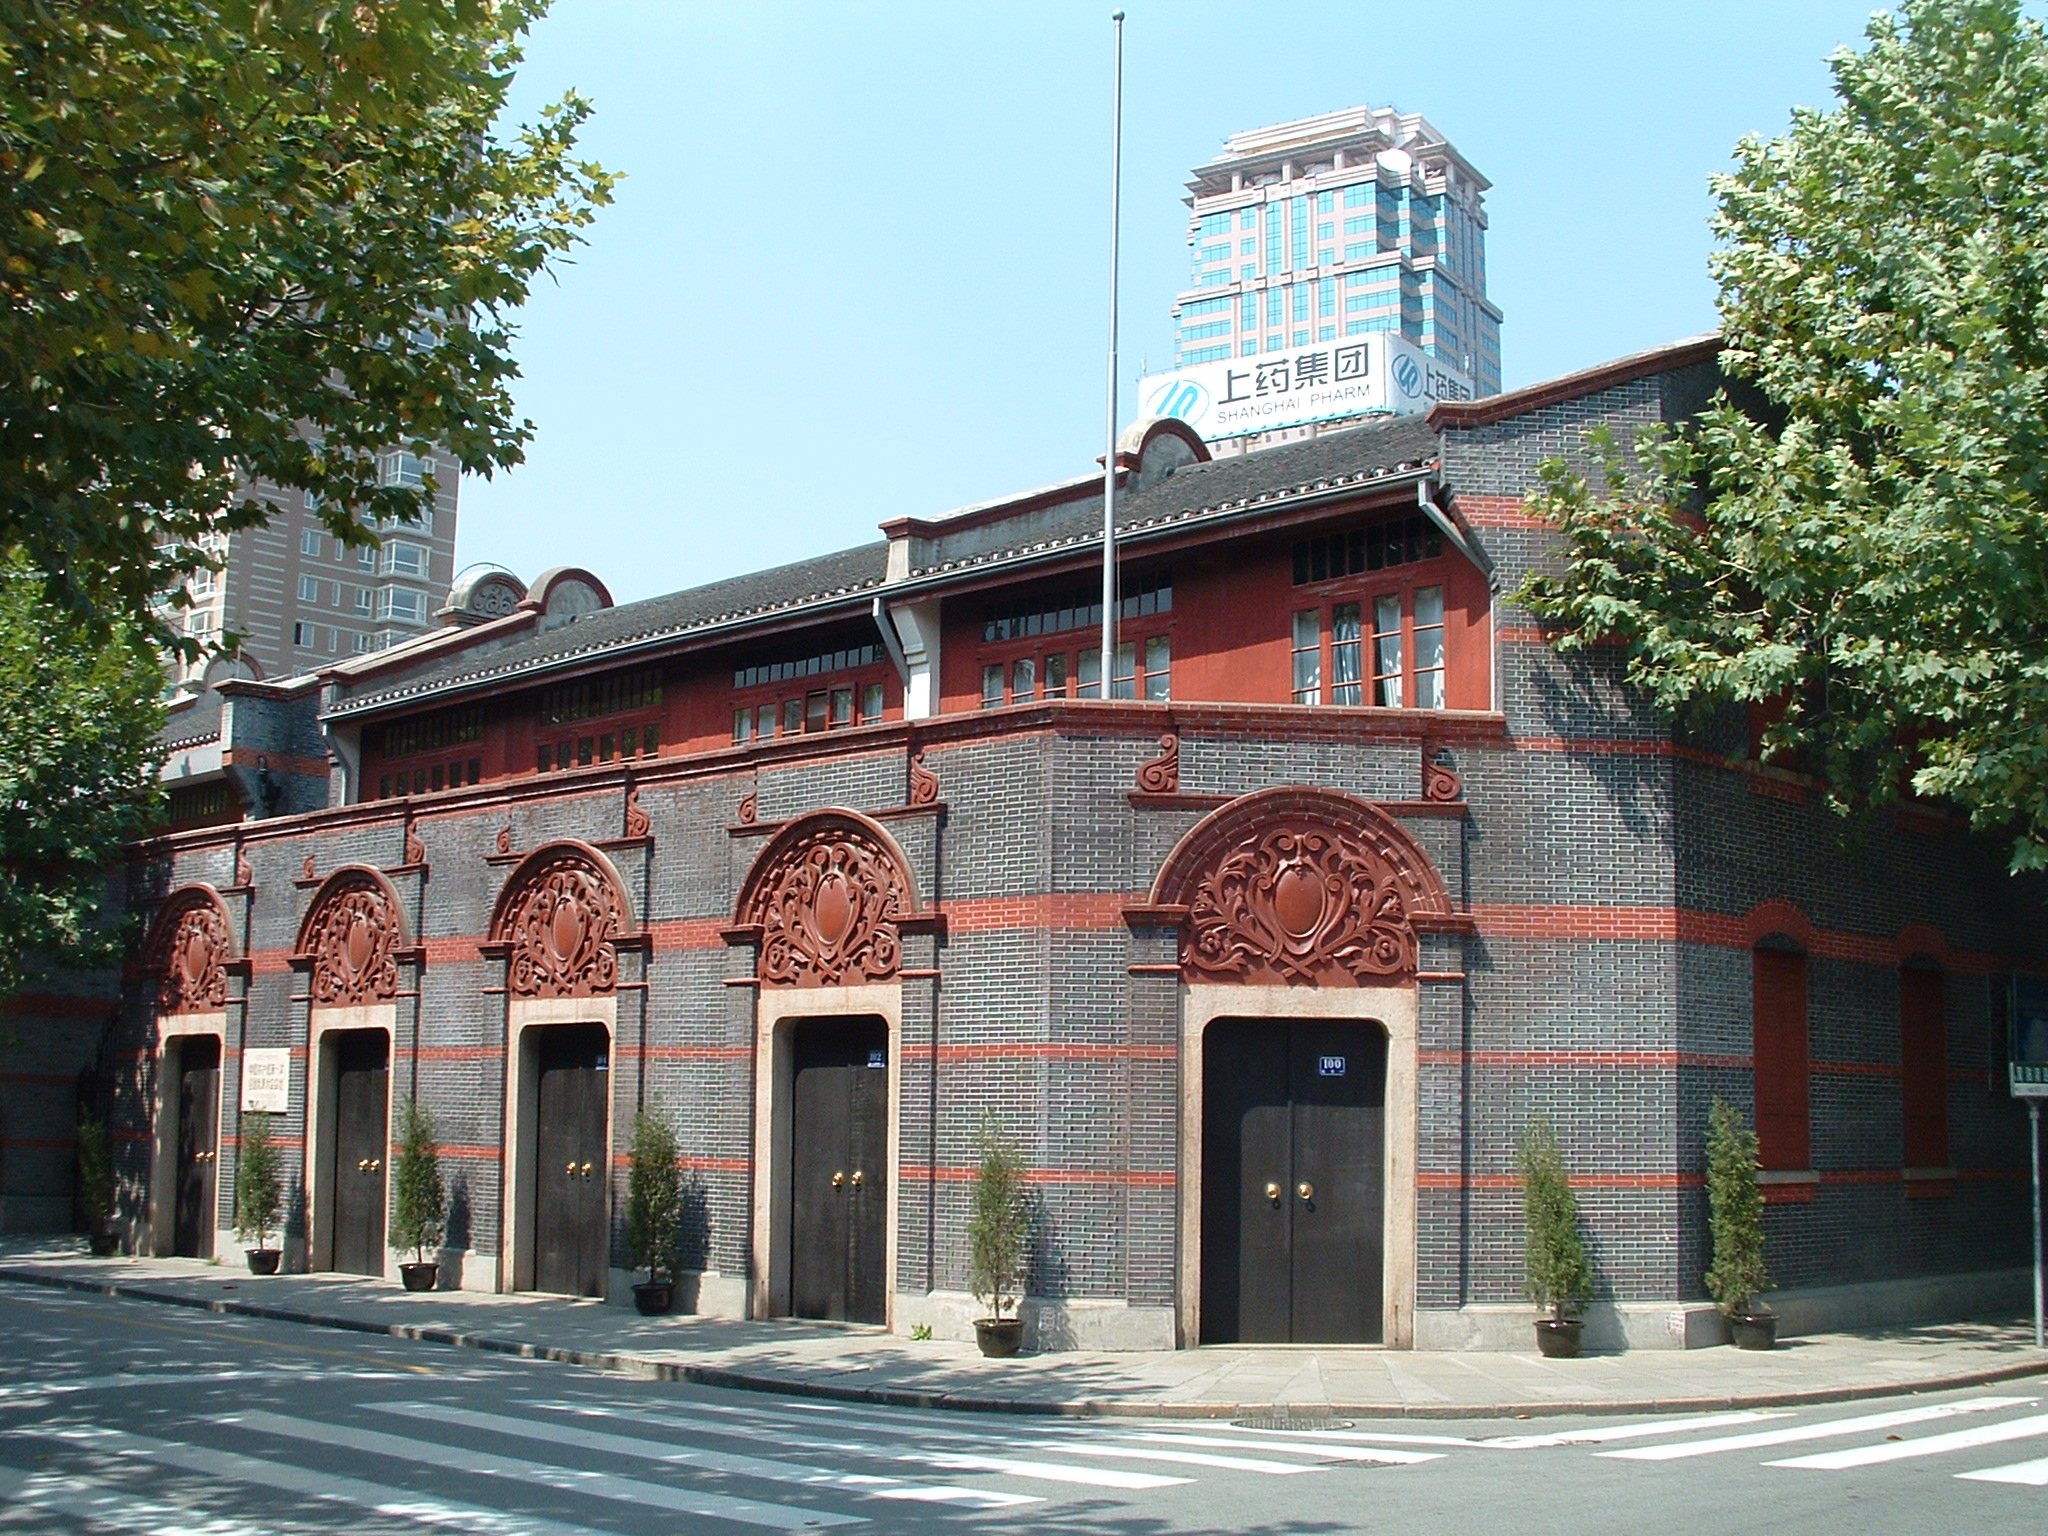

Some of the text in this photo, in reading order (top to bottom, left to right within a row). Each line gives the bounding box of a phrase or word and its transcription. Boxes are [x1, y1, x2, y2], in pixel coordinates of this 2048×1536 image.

[1218, 342, 1369, 405] 上药集团
[1217, 384, 1370, 424] SHANGHAI PHARM
[1324, 1058, 1342, 1069] 100
